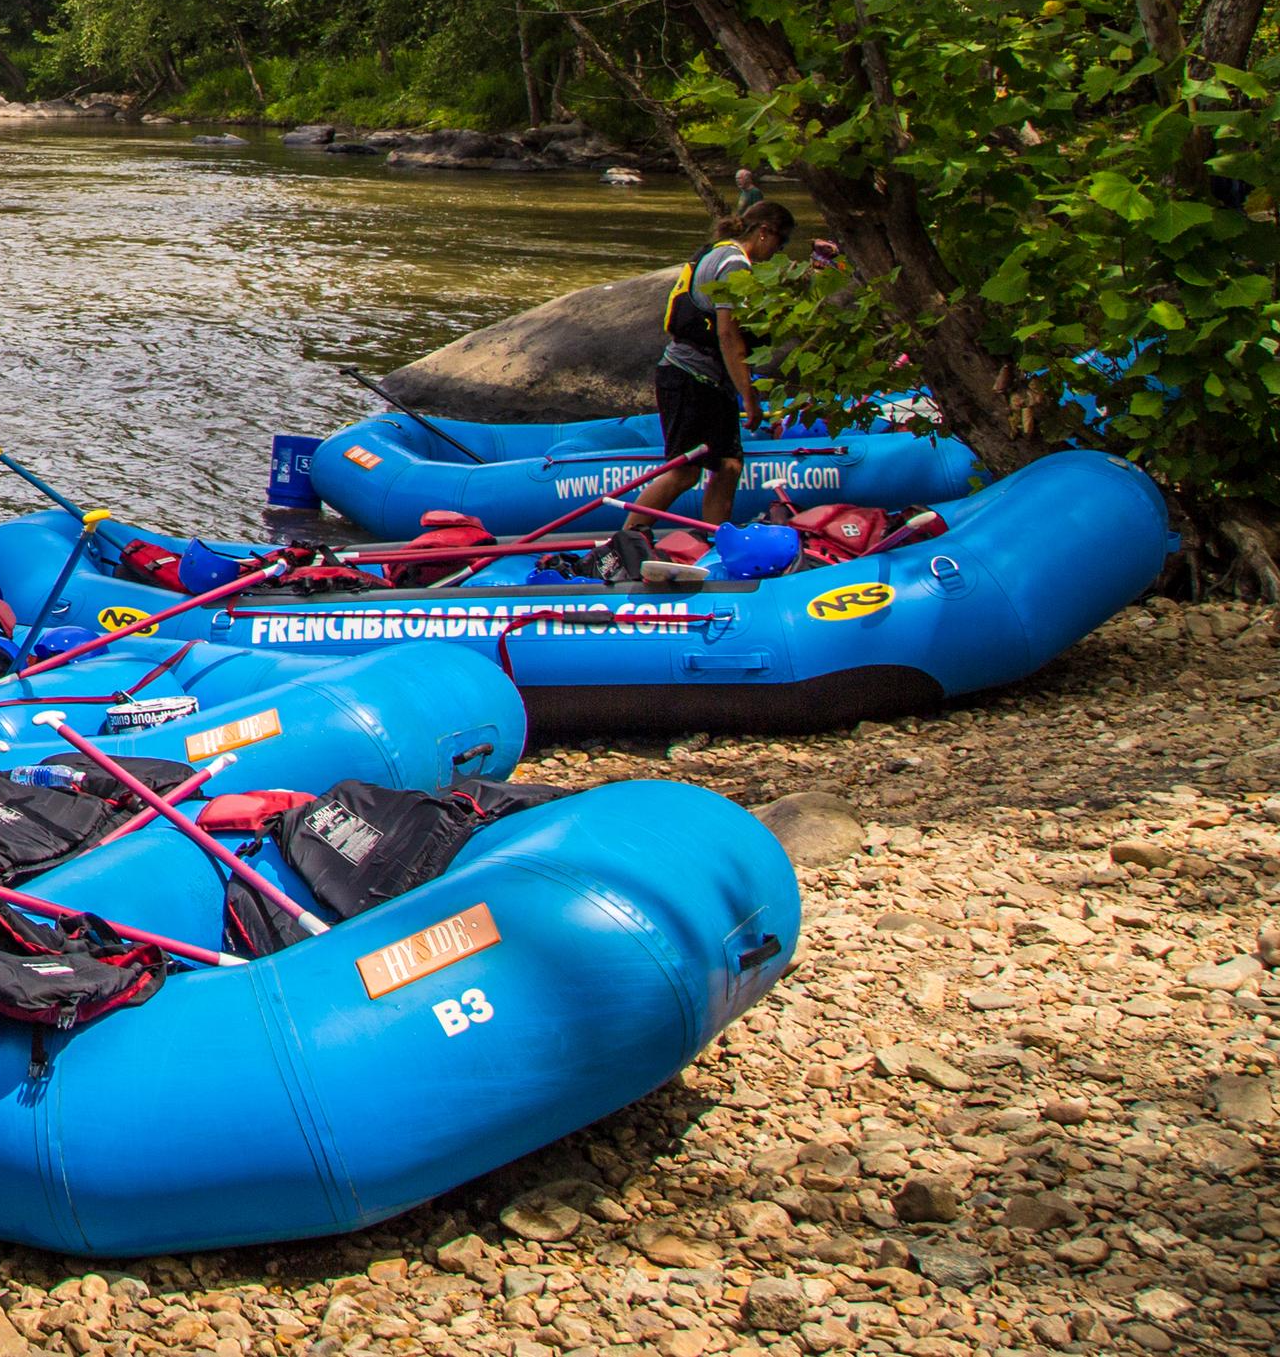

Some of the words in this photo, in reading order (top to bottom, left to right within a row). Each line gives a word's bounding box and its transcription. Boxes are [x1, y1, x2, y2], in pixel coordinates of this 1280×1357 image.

[814, 584, 890, 617] NRS
[251, 602, 688, 644] FRENCHBROADRAFTING.COM
[109, 714, 131, 726] GUIDE
[131, 711, 156, 725] YOUR
[203, 715, 263, 754] HYSIDE
[381, 915, 474, 984] HYSIDE
[432, 988, 495, 1037] B3
